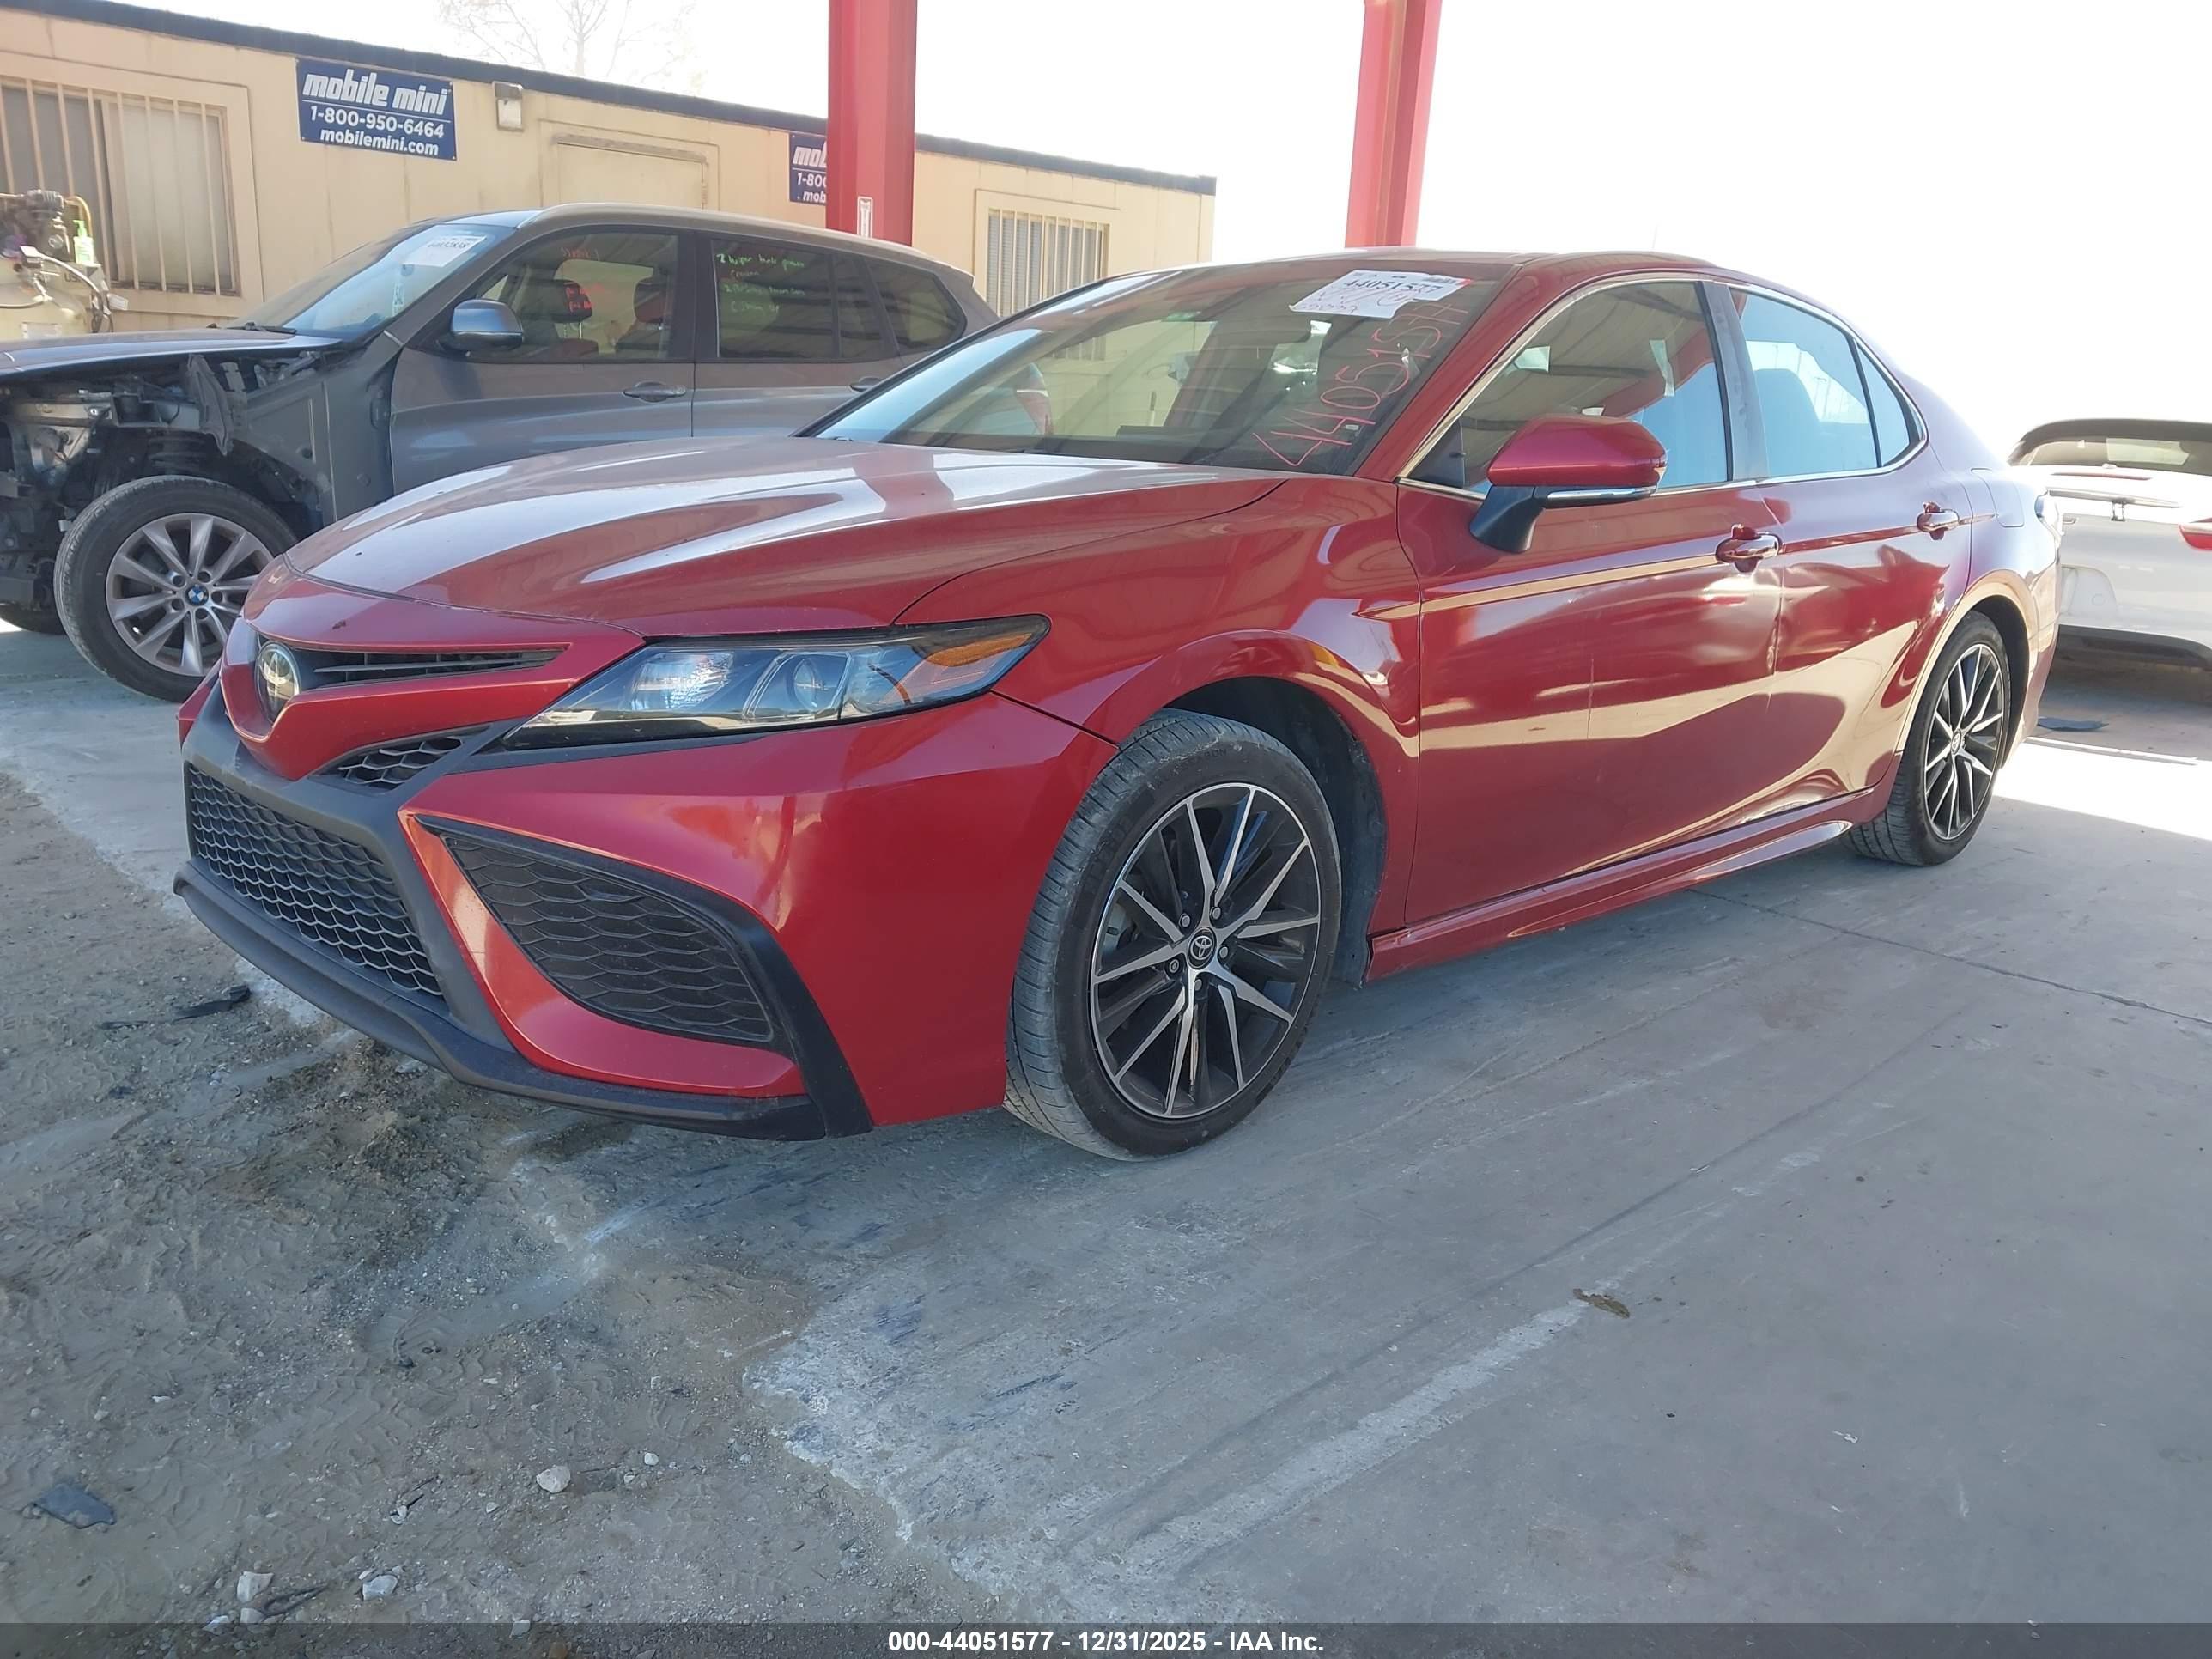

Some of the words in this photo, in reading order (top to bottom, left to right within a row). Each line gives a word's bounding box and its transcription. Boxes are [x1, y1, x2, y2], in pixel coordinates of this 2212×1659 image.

[302, 69, 390, 106] mobile
[392, 85, 448, 115] mini
[310, 105, 445, 139] 1-800-950-6464
[319, 128, 439, 156] mobilemini.com
